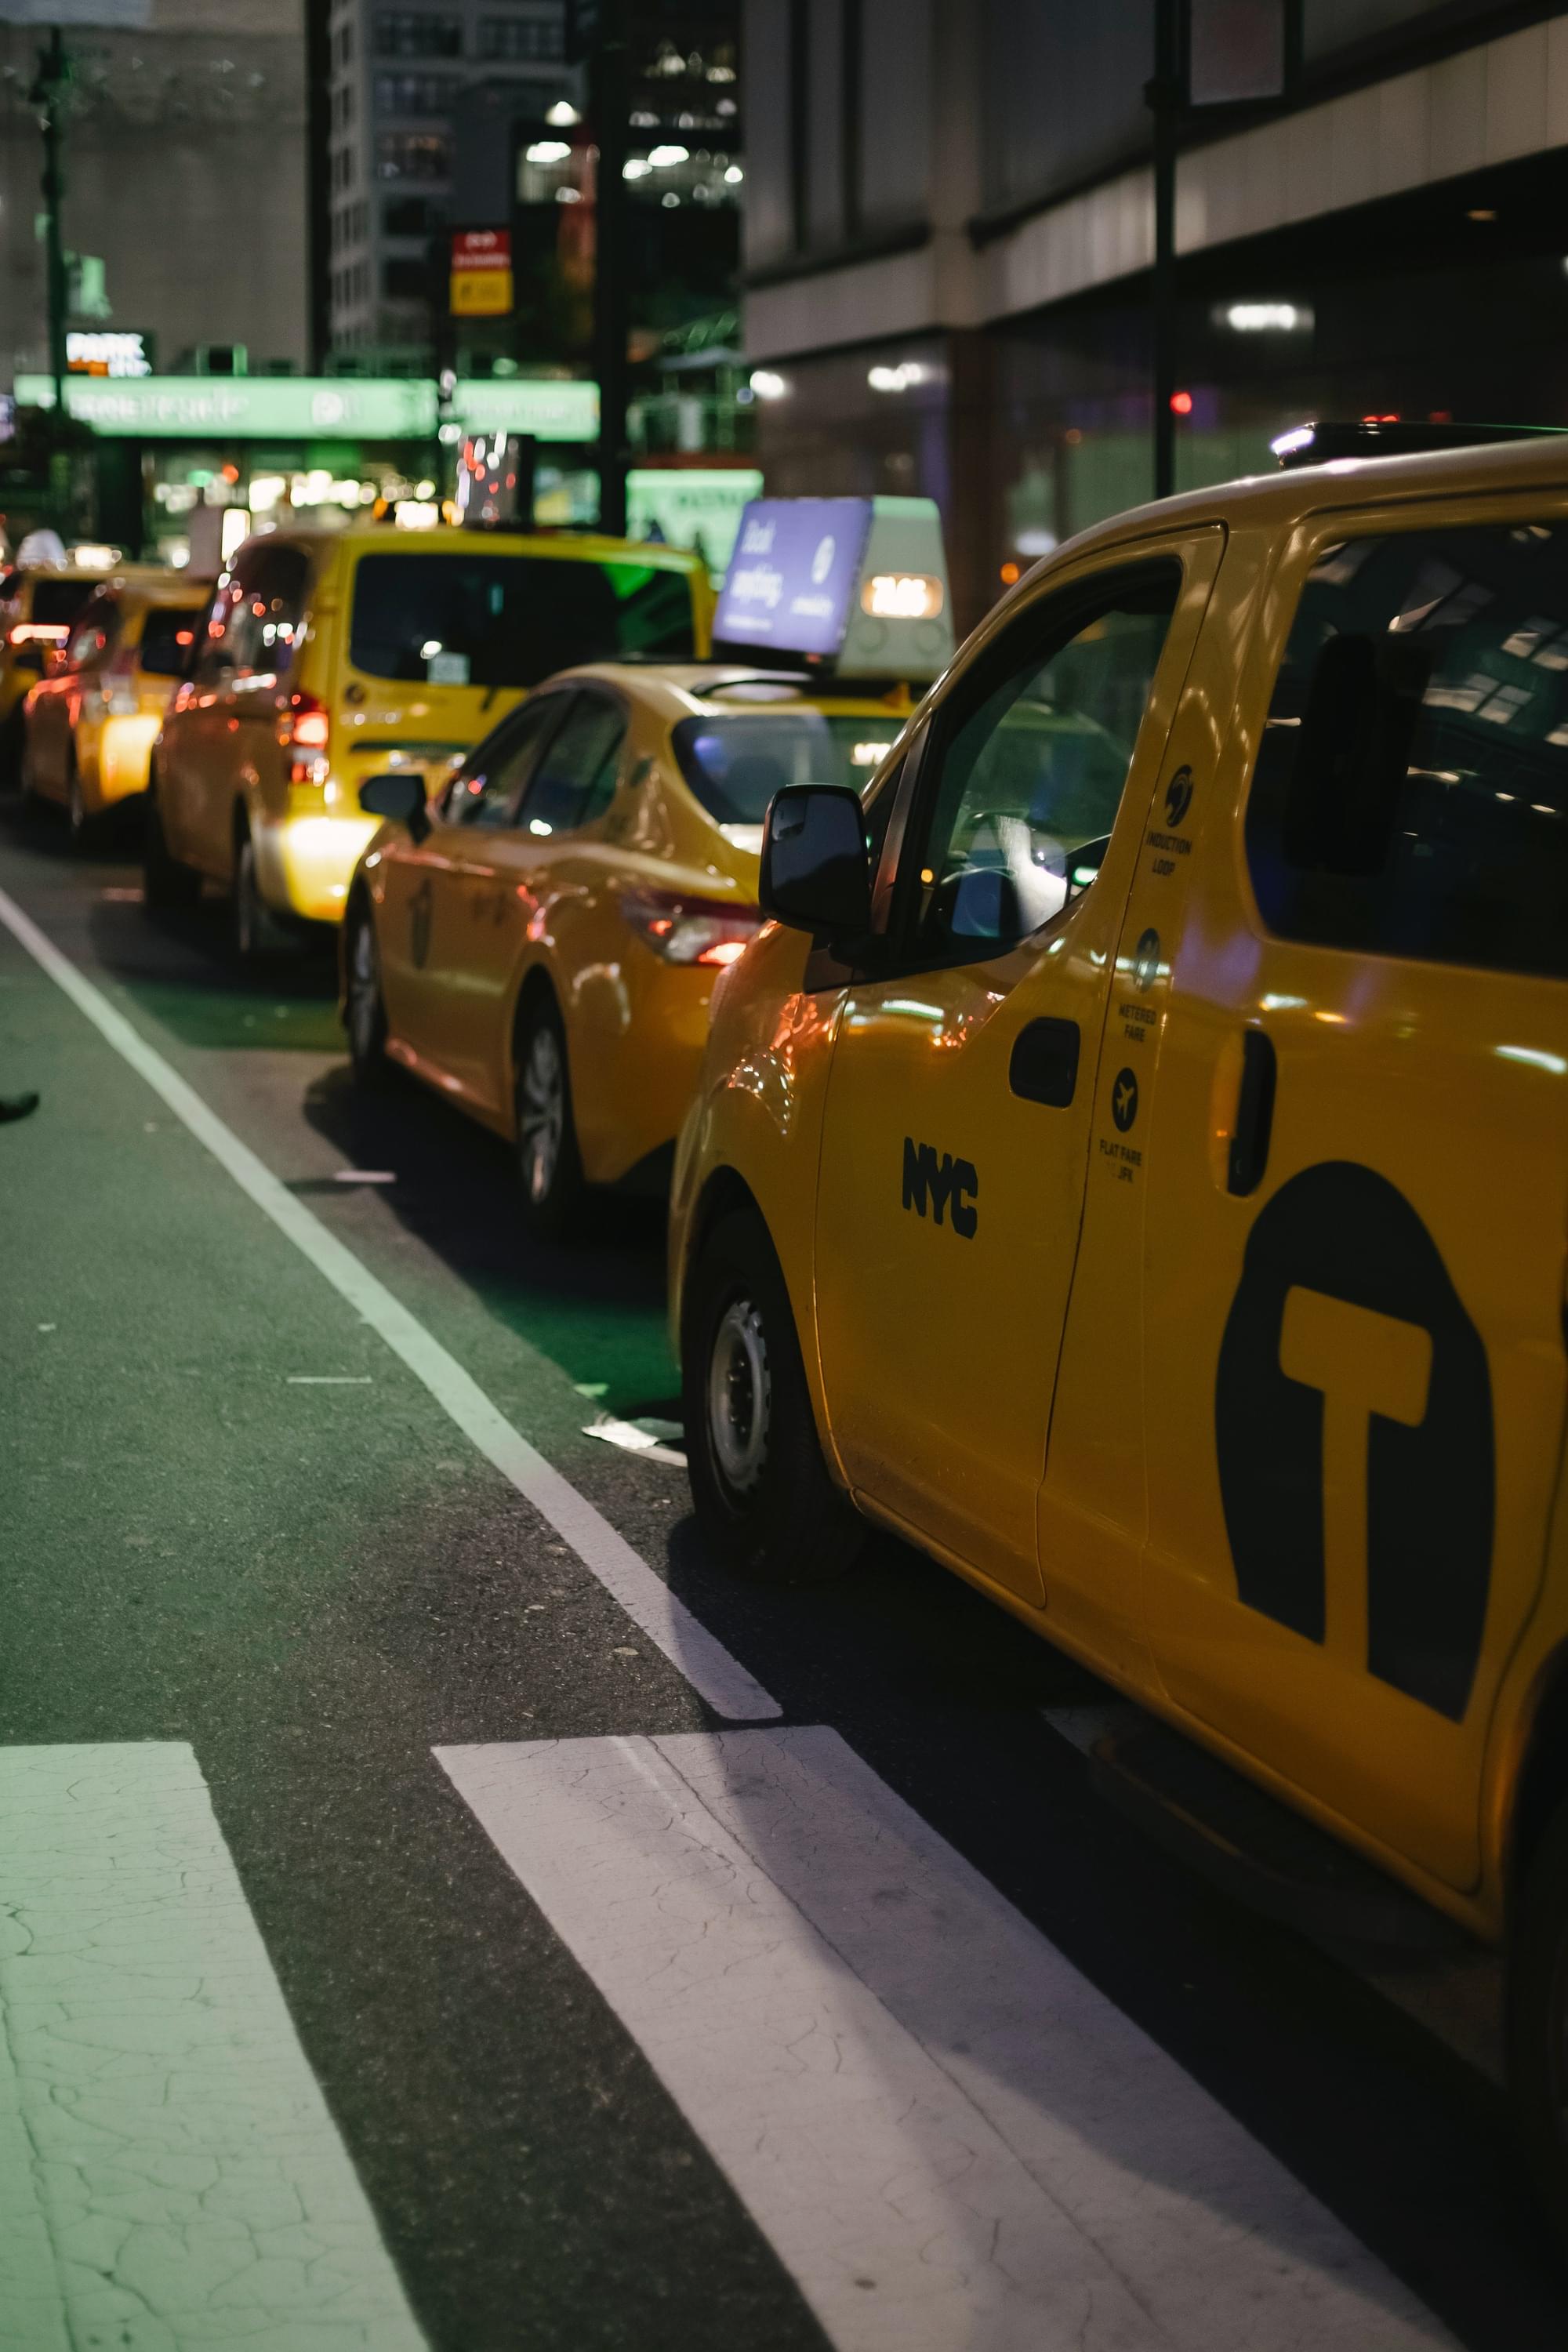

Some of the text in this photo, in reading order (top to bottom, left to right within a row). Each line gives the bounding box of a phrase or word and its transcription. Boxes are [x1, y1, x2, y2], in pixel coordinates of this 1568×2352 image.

[1147, 832, 1192, 855] INDUCTION
[1152, 858, 1175, 877] LOOP
[1119, 1004, 1156, 1025] METERED
[1125, 1025, 1145, 1042] FARE
[1100, 1139, 1142, 1167] FLAT FARE
[1118, 1166, 1134, 1183] JFK
[902, 1136, 978, 1240] NYC
